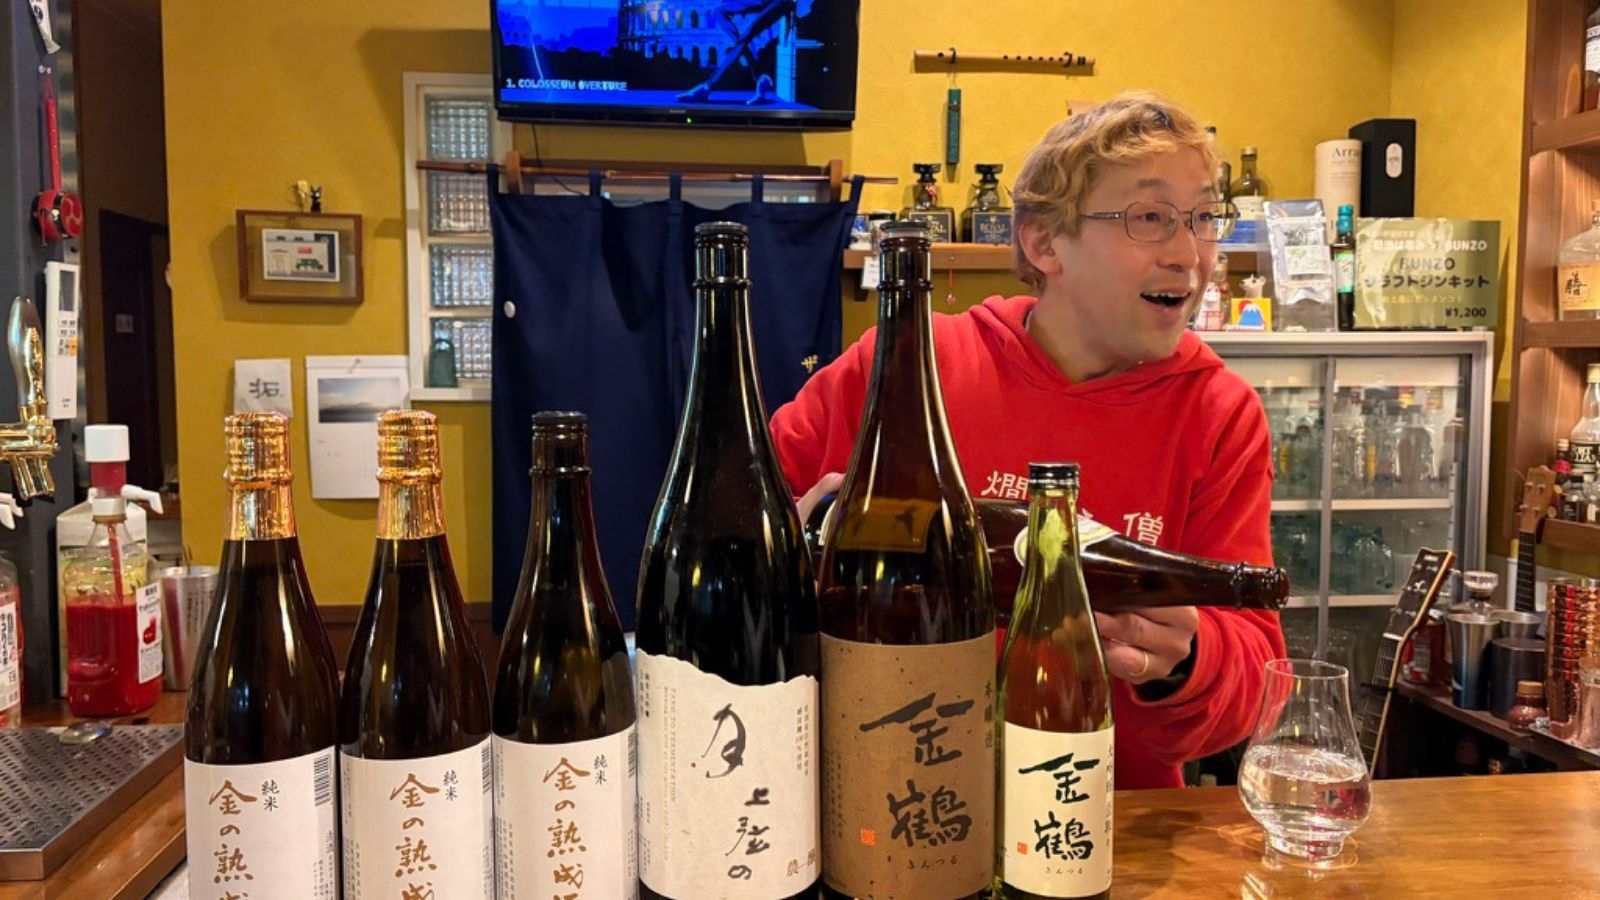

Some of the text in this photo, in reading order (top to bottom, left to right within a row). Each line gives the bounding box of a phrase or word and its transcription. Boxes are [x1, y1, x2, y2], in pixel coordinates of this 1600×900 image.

[518, 79, 576, 90] COLOSSEUM
[578, 80, 628, 91] OVERTURE
[1445, 240, 1488, 252] BUNZO
[1400, 257, 1456, 271] BUNZO
[1364, 274, 1490, 289] クラフトジンキット
[1445, 307, 1488, 320] ¥1,200
[593, 754, 608, 785] 純米
[443, 769, 459, 802] 純米
[261, 779, 280, 812] 純米
